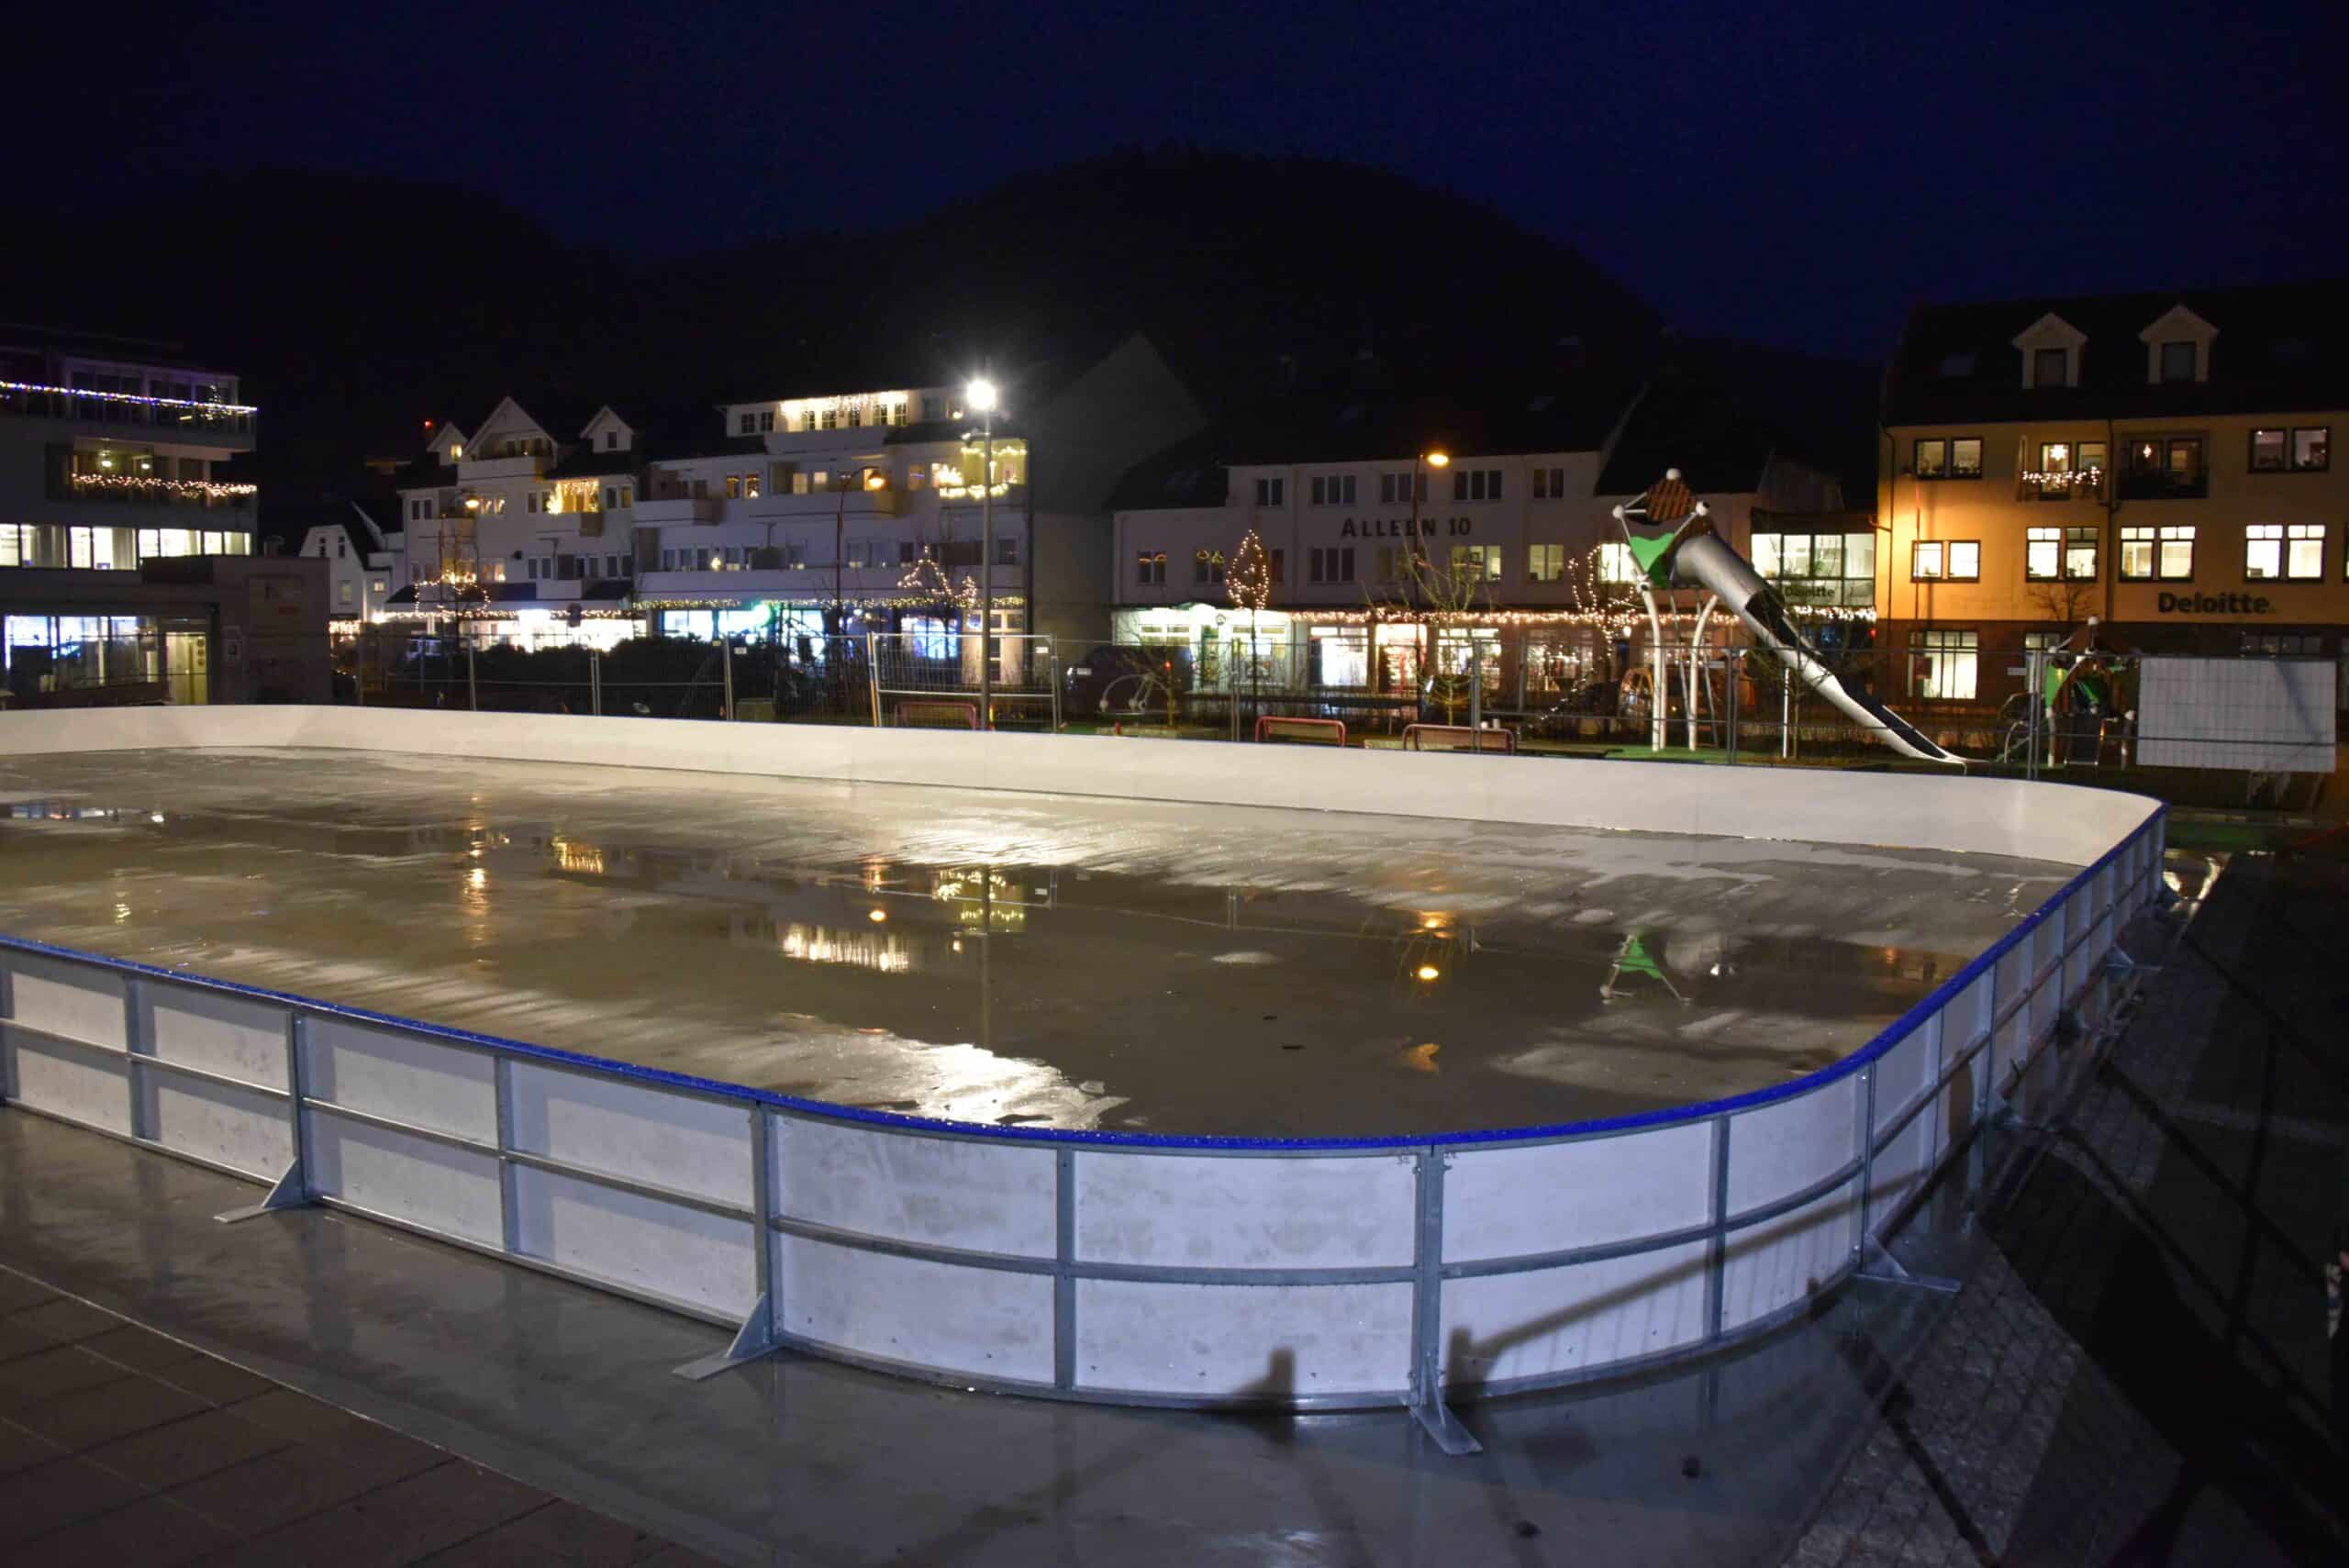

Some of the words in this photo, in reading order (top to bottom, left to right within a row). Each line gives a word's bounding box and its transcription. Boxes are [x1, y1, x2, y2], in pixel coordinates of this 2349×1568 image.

[1341, 517, 1436, 537] ALLEEN
[1448, 517, 1472, 536] 10
[1785, 585, 1836, 596] Doitte
